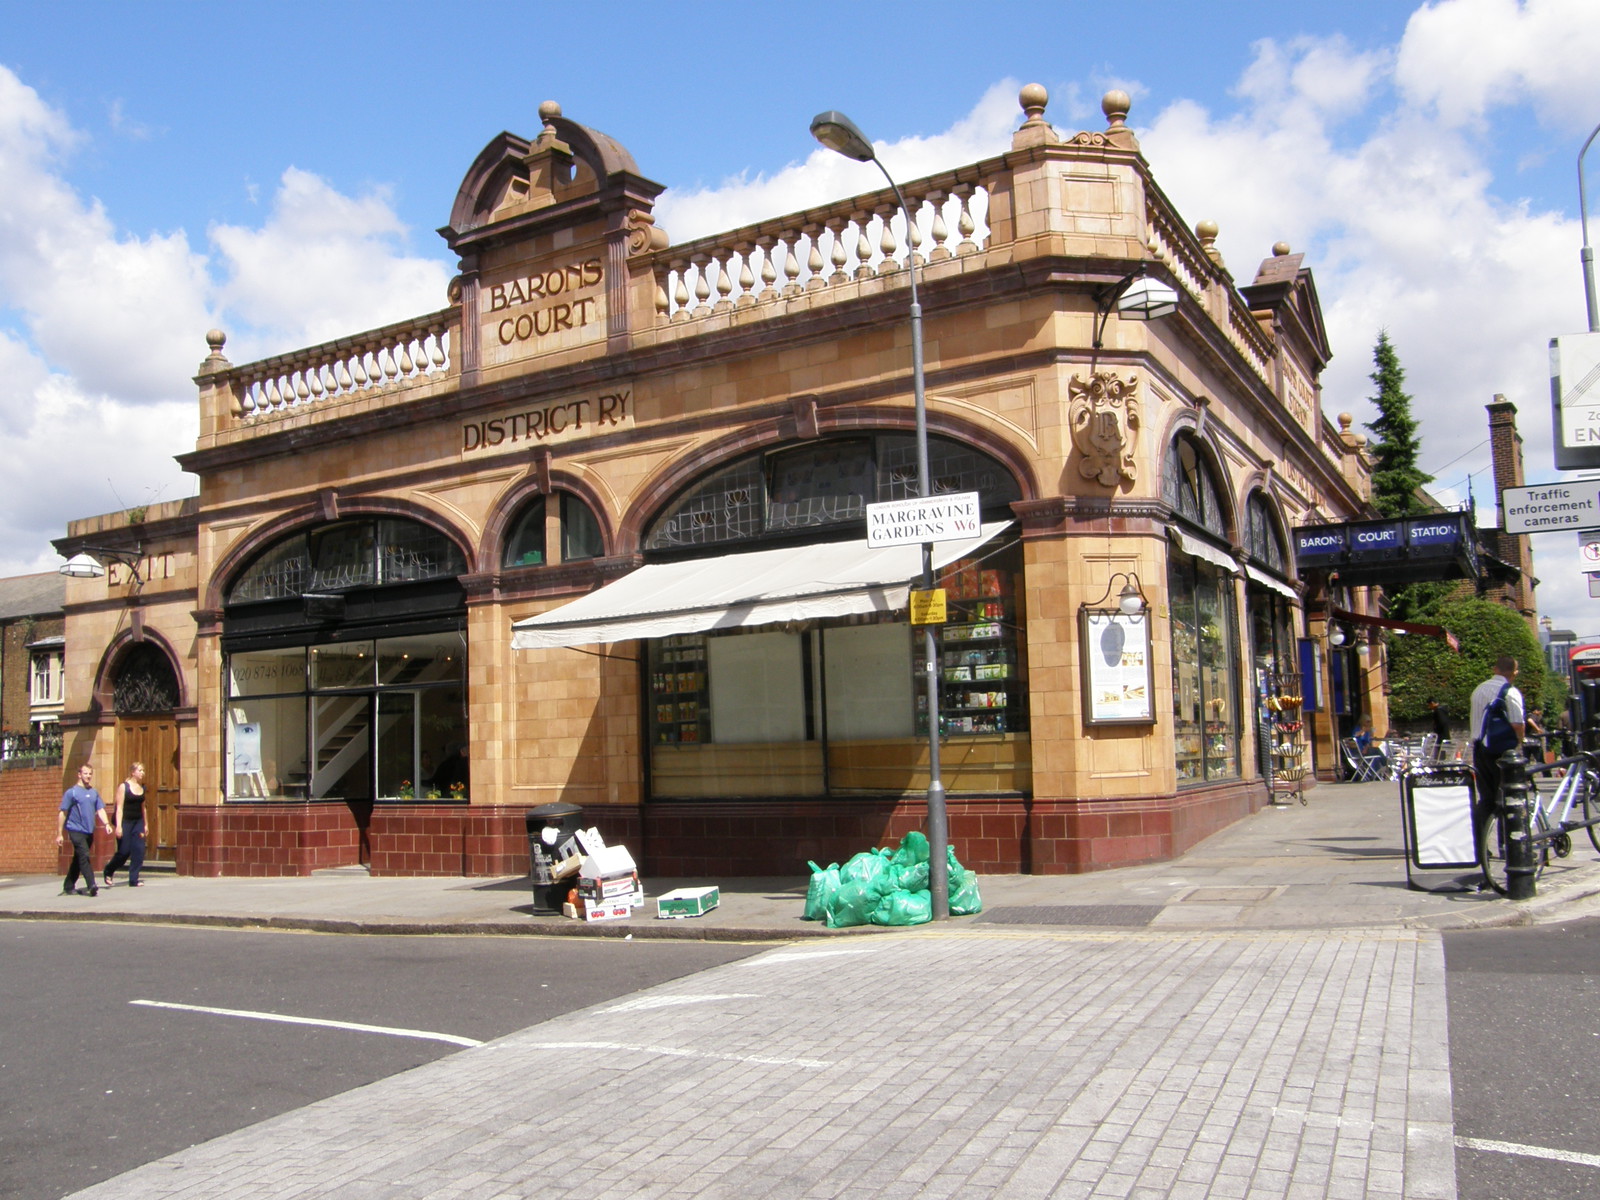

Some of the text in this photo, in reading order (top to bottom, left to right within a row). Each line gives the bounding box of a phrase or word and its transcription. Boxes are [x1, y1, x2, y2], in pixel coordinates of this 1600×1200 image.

[490, 258, 603, 312] BARONS
[498, 297, 595, 346] COURT
[464, 400, 590, 451] DISTRICT
[1527, 489, 1570, 501] Traffic
[872, 503, 975, 526] MARGRAVINE
[1509, 499, 1593, 515] enforcement
[872, 519, 976, 540] GARDENS W6
[1524, 514, 1579, 526] cameras
[1300, 525, 1457, 548] BARONS COURT STATION
[108, 551, 175, 587] EXIT
[234, 667, 251, 681] 020
[254, 665, 277, 680] 8748
[281, 663, 305, 677] 1068
